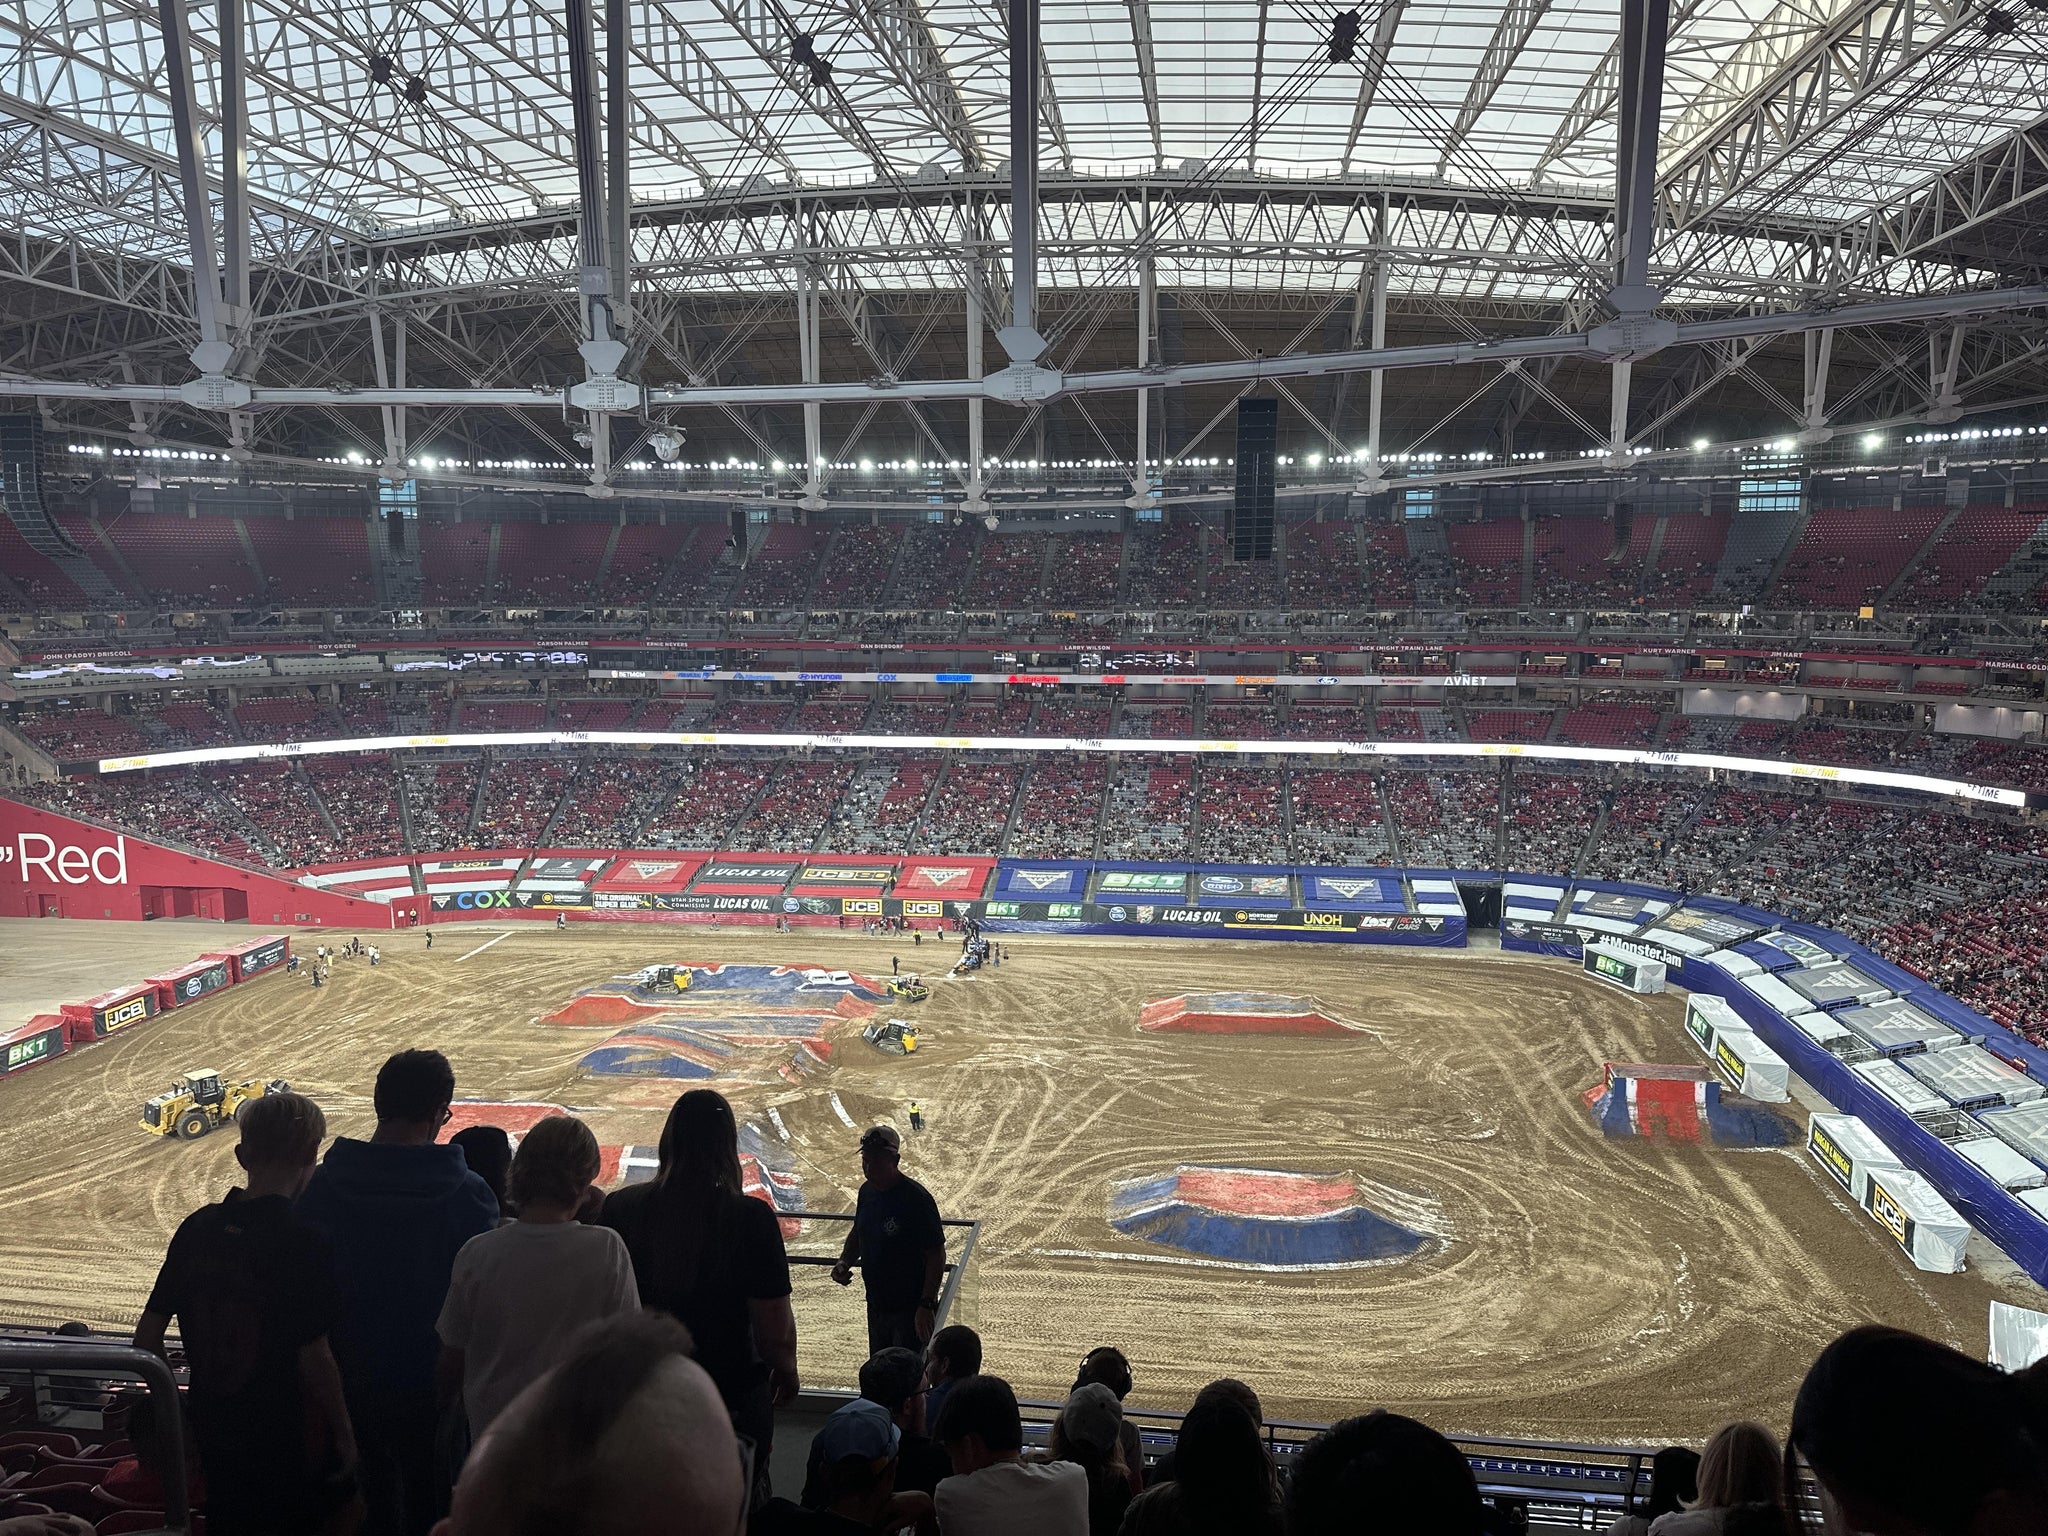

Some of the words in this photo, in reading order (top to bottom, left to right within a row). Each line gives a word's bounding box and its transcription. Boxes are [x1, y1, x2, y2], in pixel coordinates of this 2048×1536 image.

[1985, 661, 2025, 669] MARSHALL
[2026, 663, 2048, 671] GOLD
[1443, 676, 1488, 686] AVNET
[706, 868, 760, 877] LUCAS
[761, 869, 790, 878] OIL
[806, 869, 855, 878] JCB
[1103, 874, 1185, 888] BKT
[457, 891, 511, 909] COX
[713, 898, 750, 909] LUCAS
[750, 898, 770, 910] OIL
[845, 902, 879, 912] JCB
[906, 903, 940, 914] JCB
[986, 903, 1019, 915] BKT
[1048, 904, 1082, 917] BKT
[1162, 910, 1202, 922] LUCAS
[1202, 911, 1223, 923] OIL
[1303, 912, 1343, 924] UNOH
[1599, 934, 1682, 968] #MonsterJam
[1772, 937, 1822, 956] COX
[1596, 956, 1625, 976] BKT
[109, 1002, 143, 1025] JCB
[8, 1035, 47, 1065] BKT
[1876, 1195, 1903, 1235] JCB
